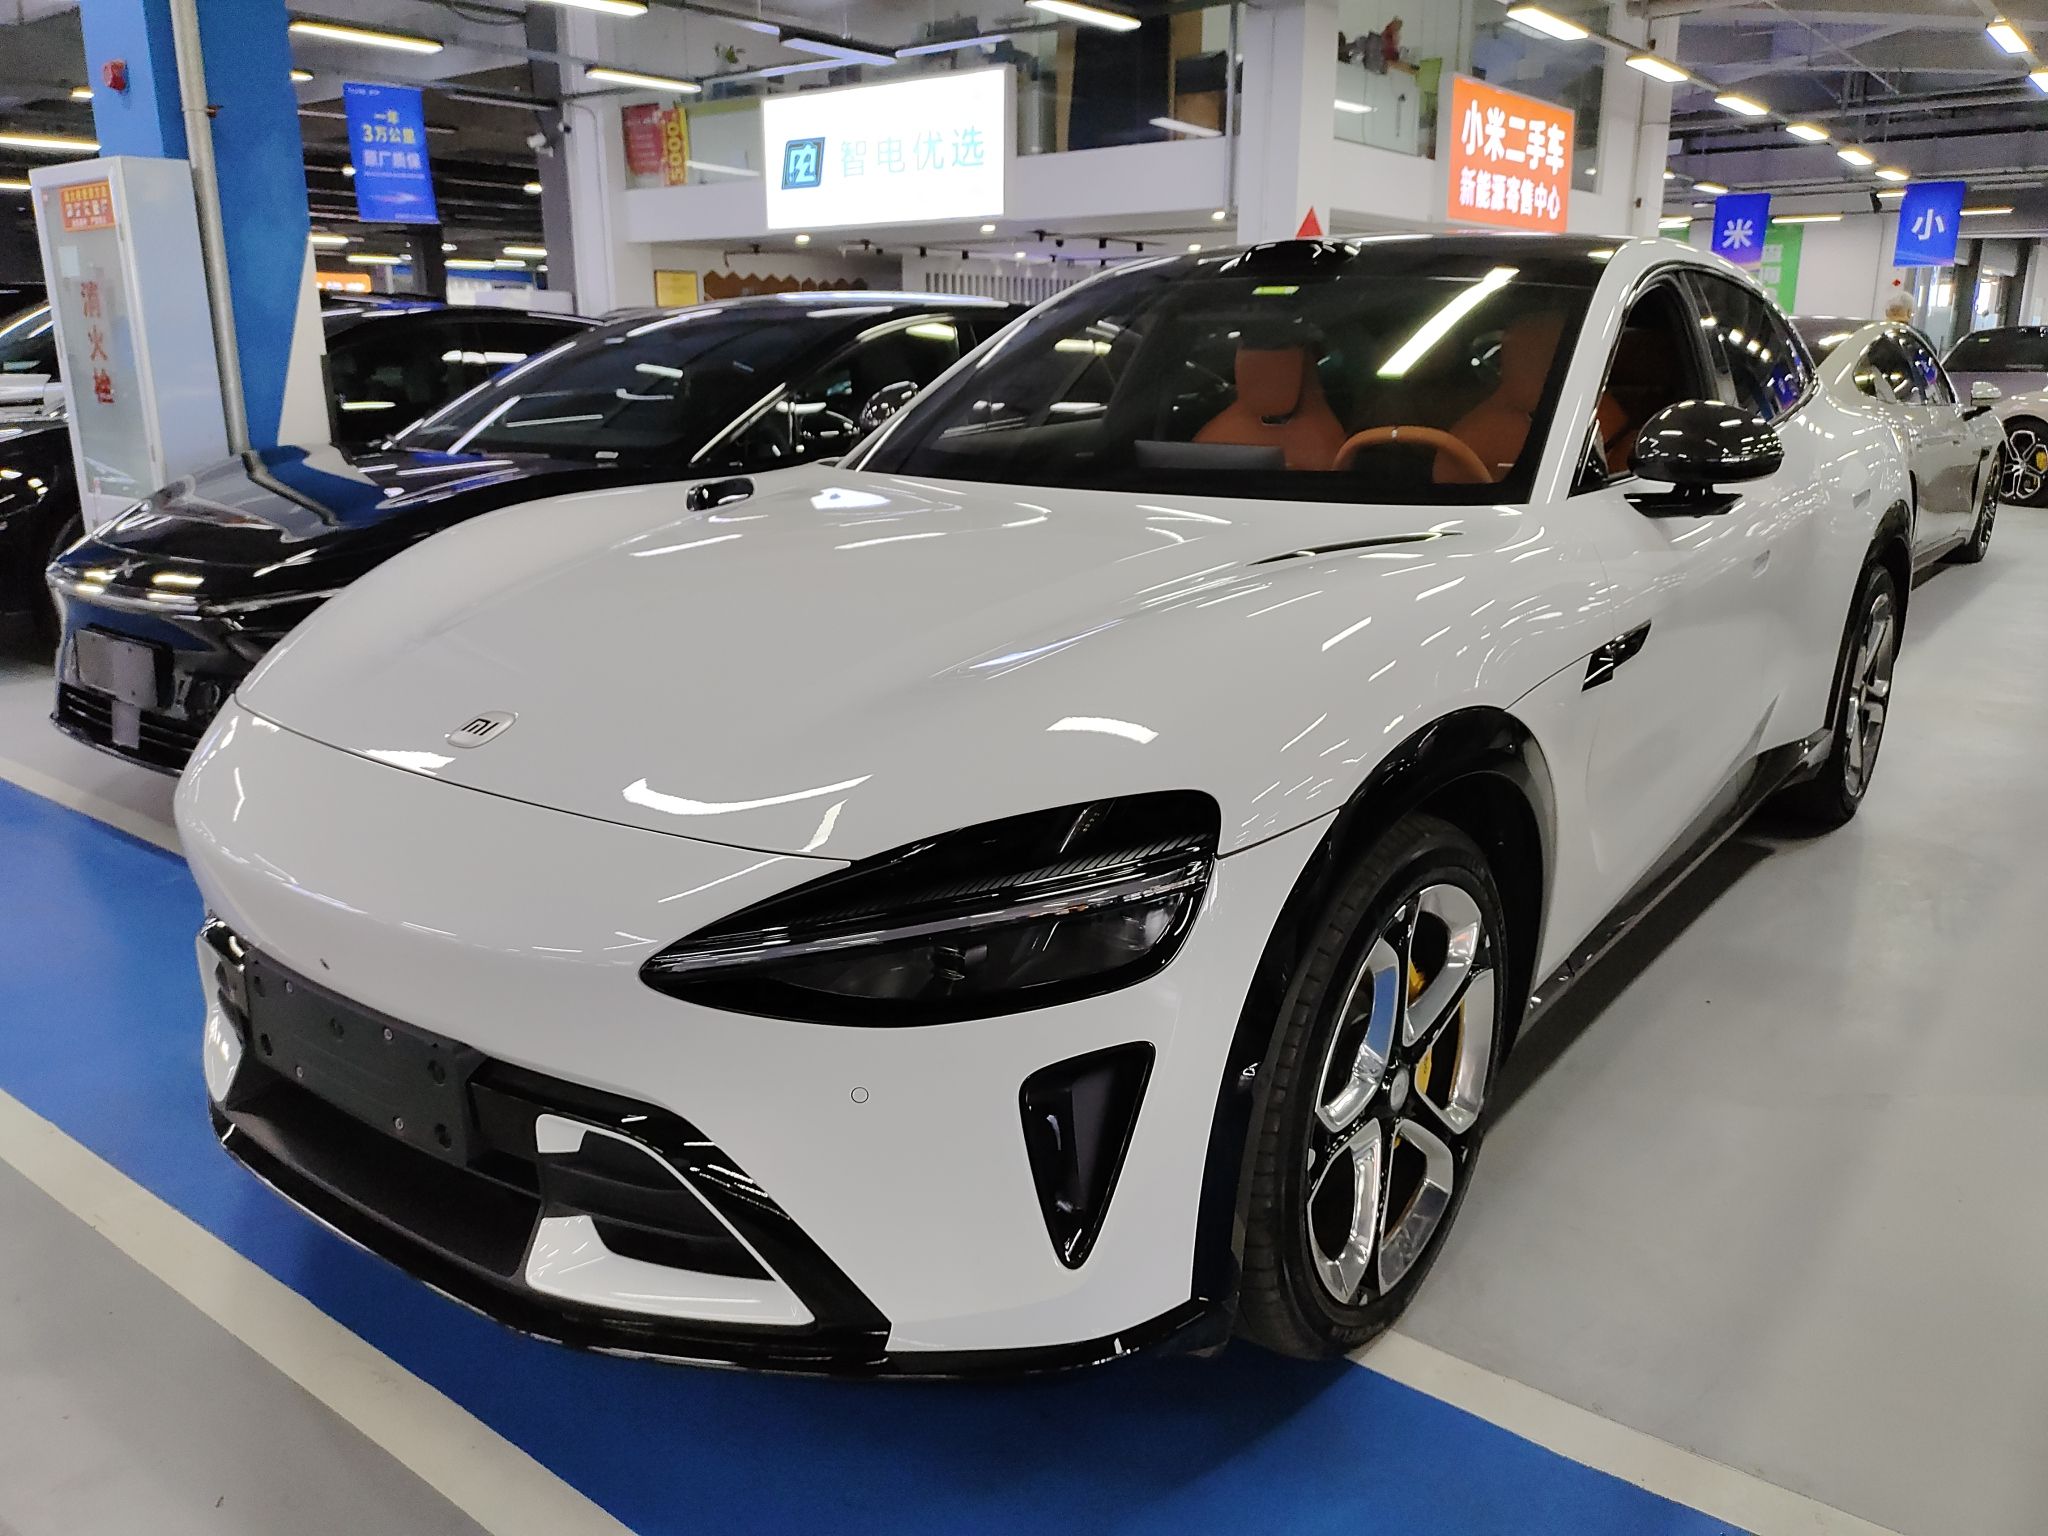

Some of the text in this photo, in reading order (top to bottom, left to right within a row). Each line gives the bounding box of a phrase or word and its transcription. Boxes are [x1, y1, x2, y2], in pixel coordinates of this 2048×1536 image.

[841, 126, 985, 178] 智电优选
[1461, 99, 1565, 176] 小米二手车
[1459, 165, 1561, 220] 新能源寄售中心
[1722, 218, 1753, 249] 米
[1911, 208, 1945, 241] 小
[80, 281, 115, 403] 消火栓
